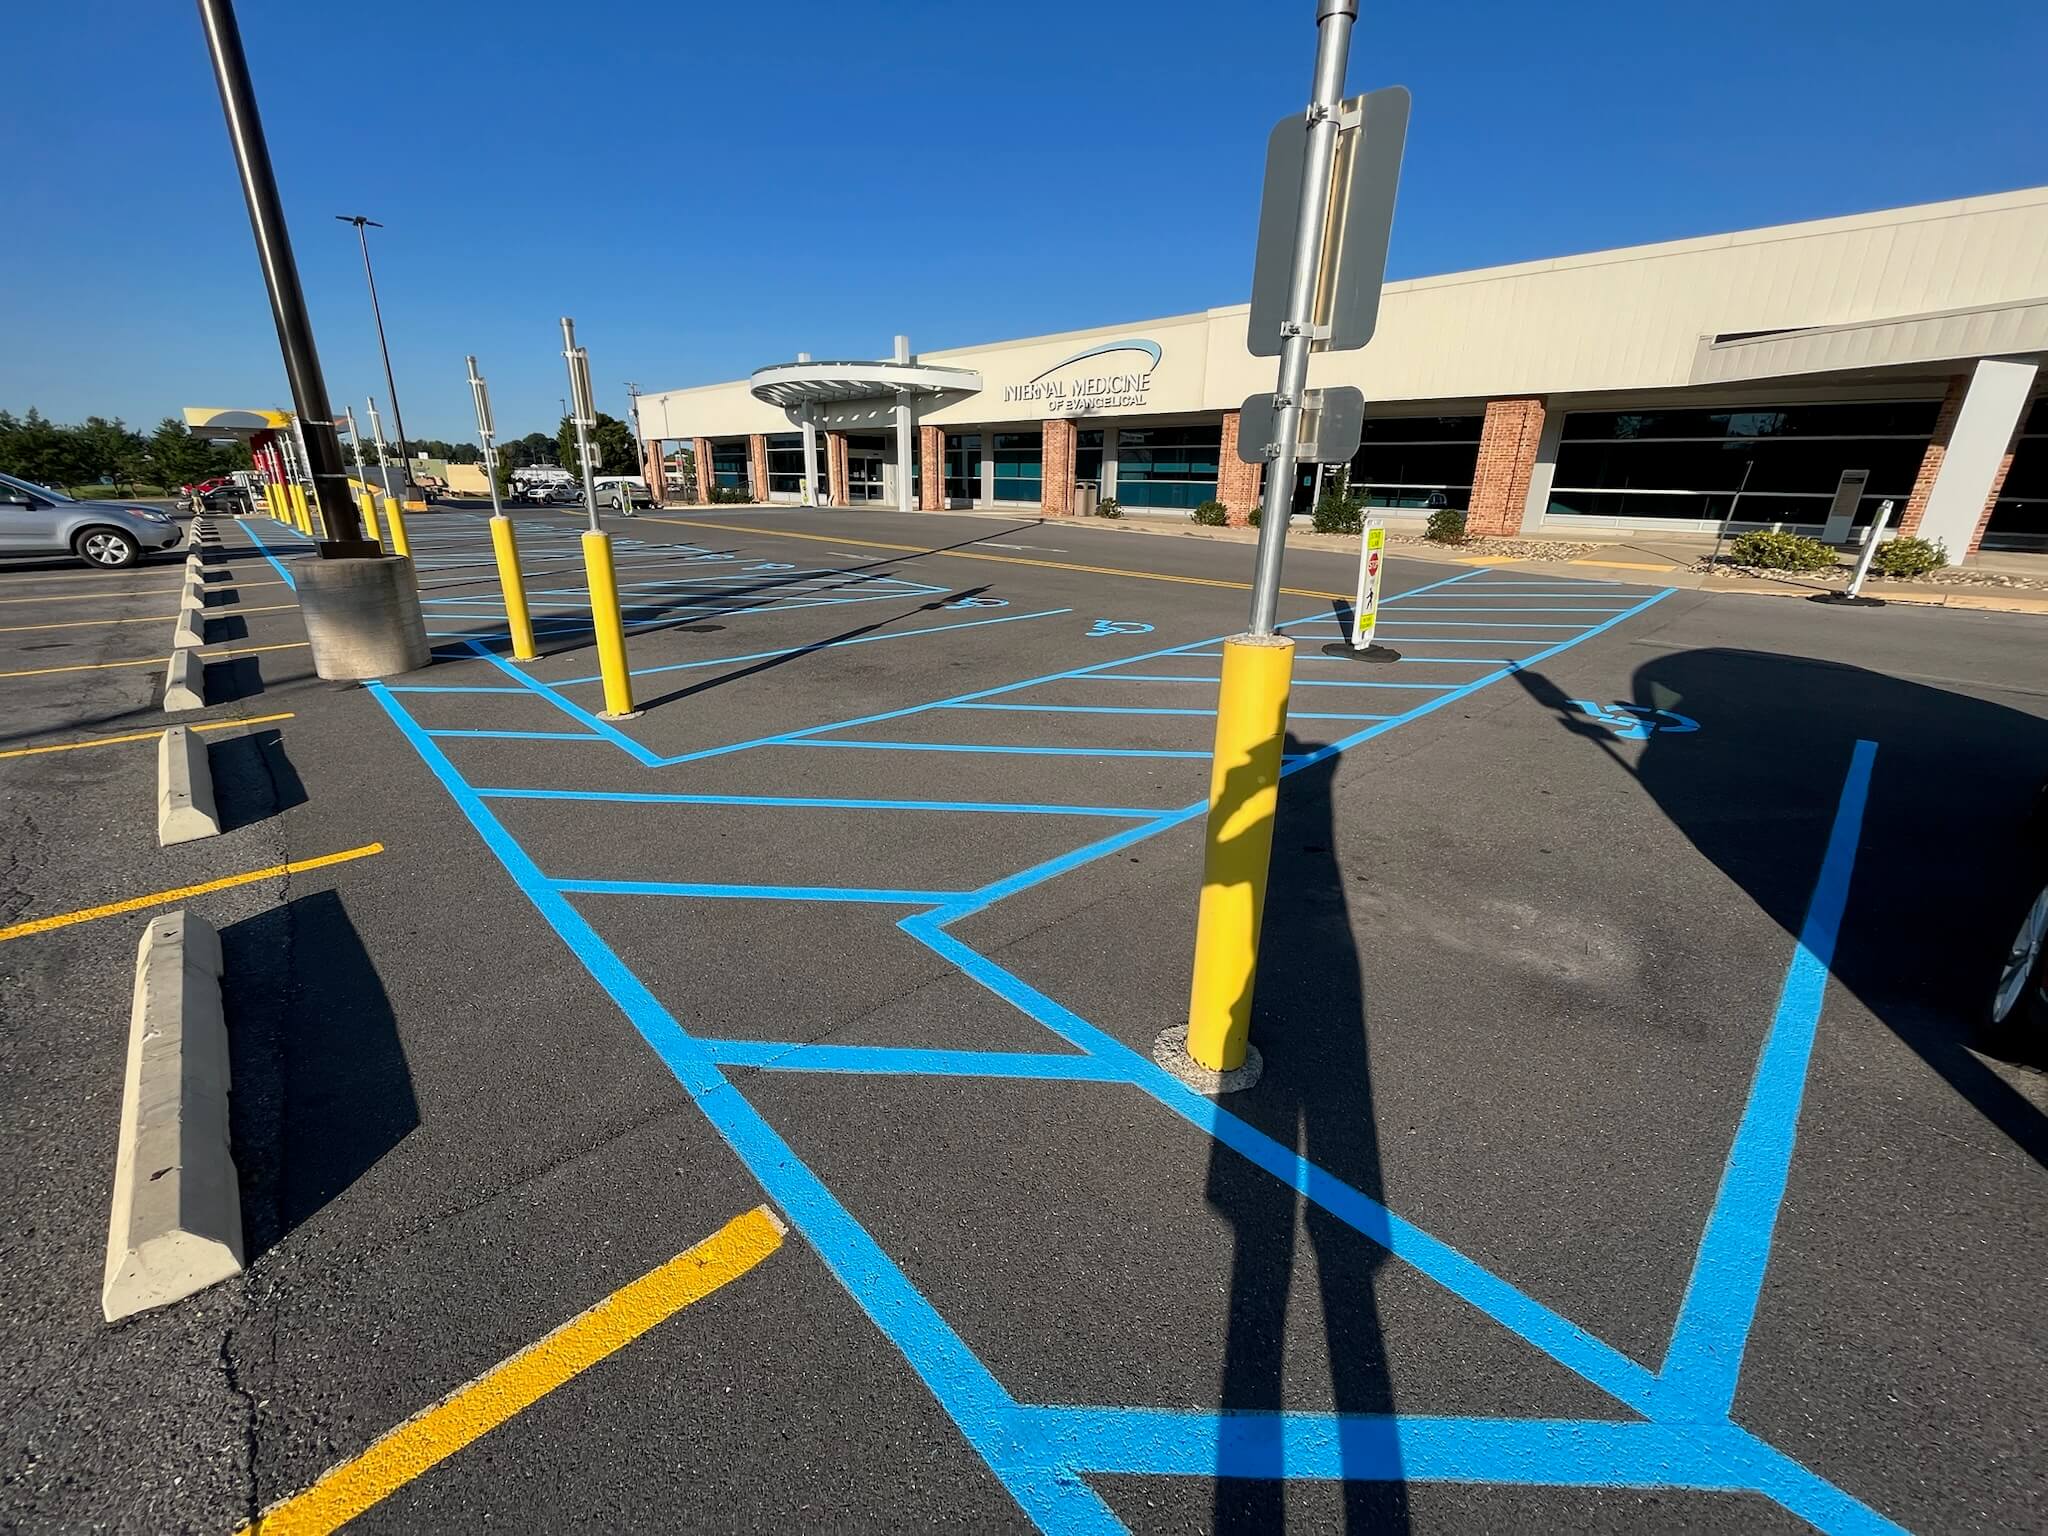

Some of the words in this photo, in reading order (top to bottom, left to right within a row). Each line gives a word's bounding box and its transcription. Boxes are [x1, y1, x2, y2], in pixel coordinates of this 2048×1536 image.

[1004, 381, 1067, 402] INTERNAL
[1072, 373, 1151, 396] MEDICINE
[1049, 400, 1065, 411] OF
[1066, 395, 1147, 411] EVANGELICAL
